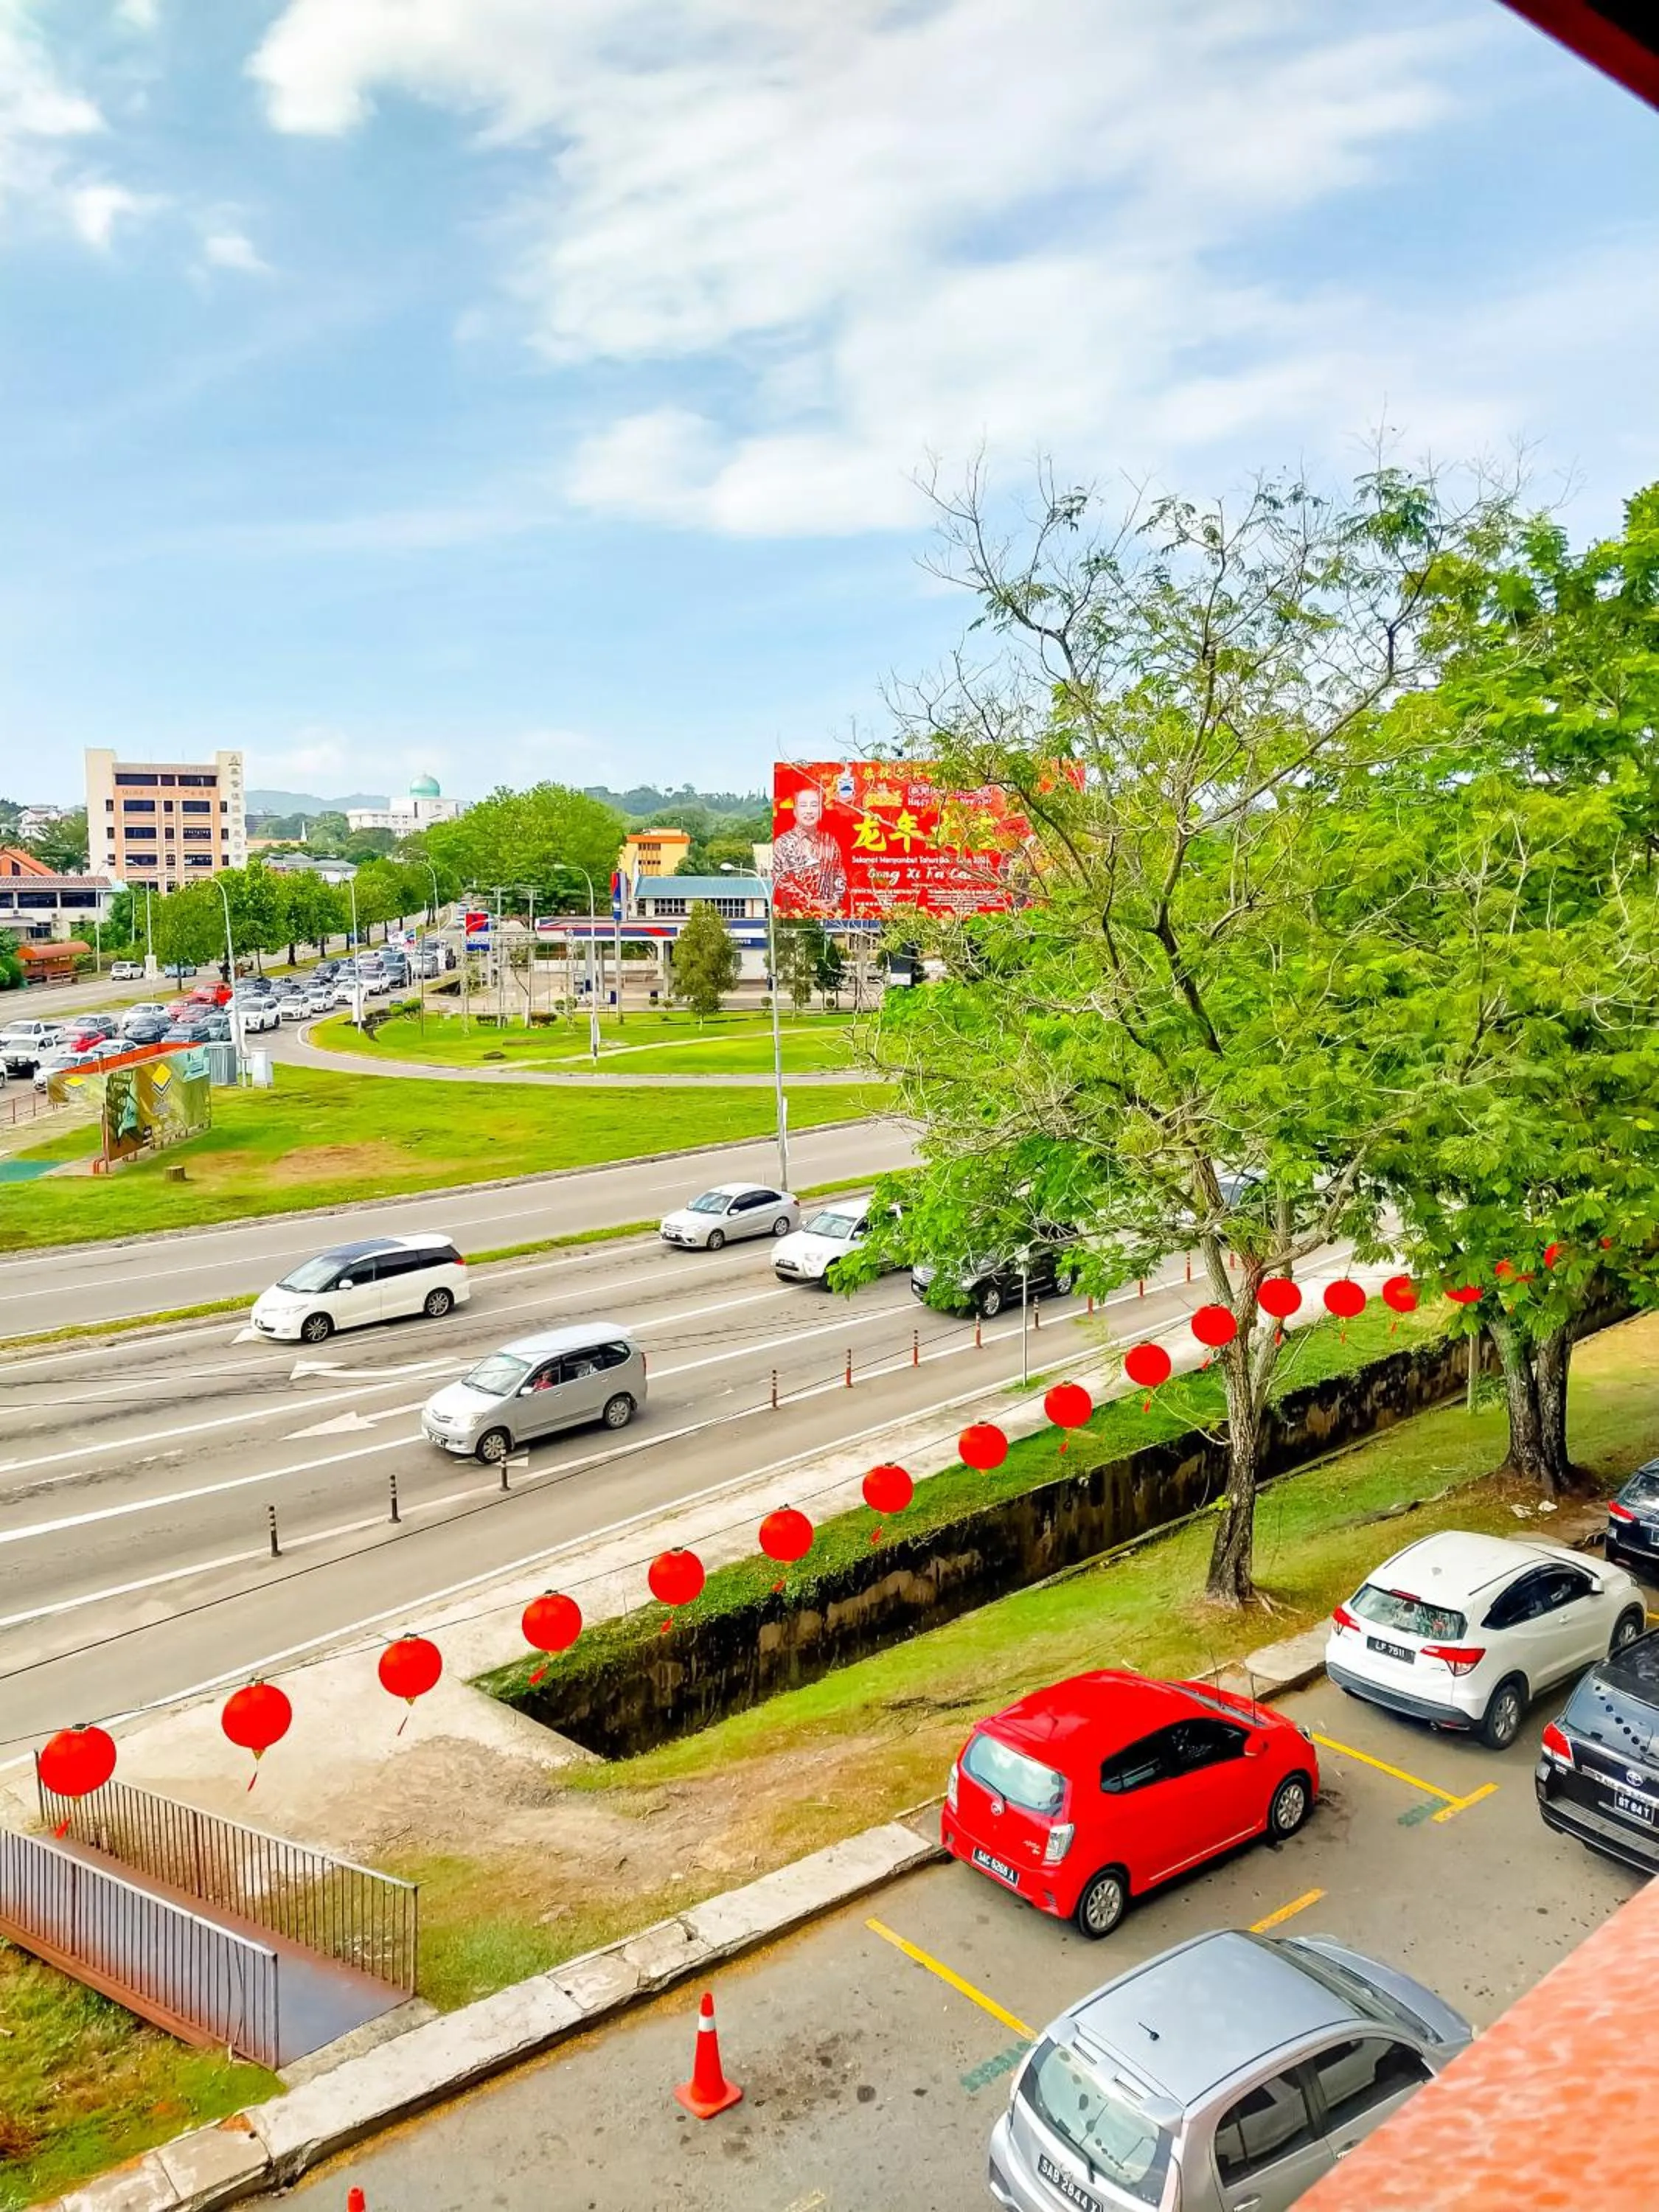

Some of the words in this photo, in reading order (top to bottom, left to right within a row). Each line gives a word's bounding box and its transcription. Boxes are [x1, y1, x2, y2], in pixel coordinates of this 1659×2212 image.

[852, 855, 877, 864] Selamat
[1008, 1869, 1015, 1881] A
[1041, 2158, 1060, 2183] SAB
[1062, 2177, 1088, 2210] 2844
